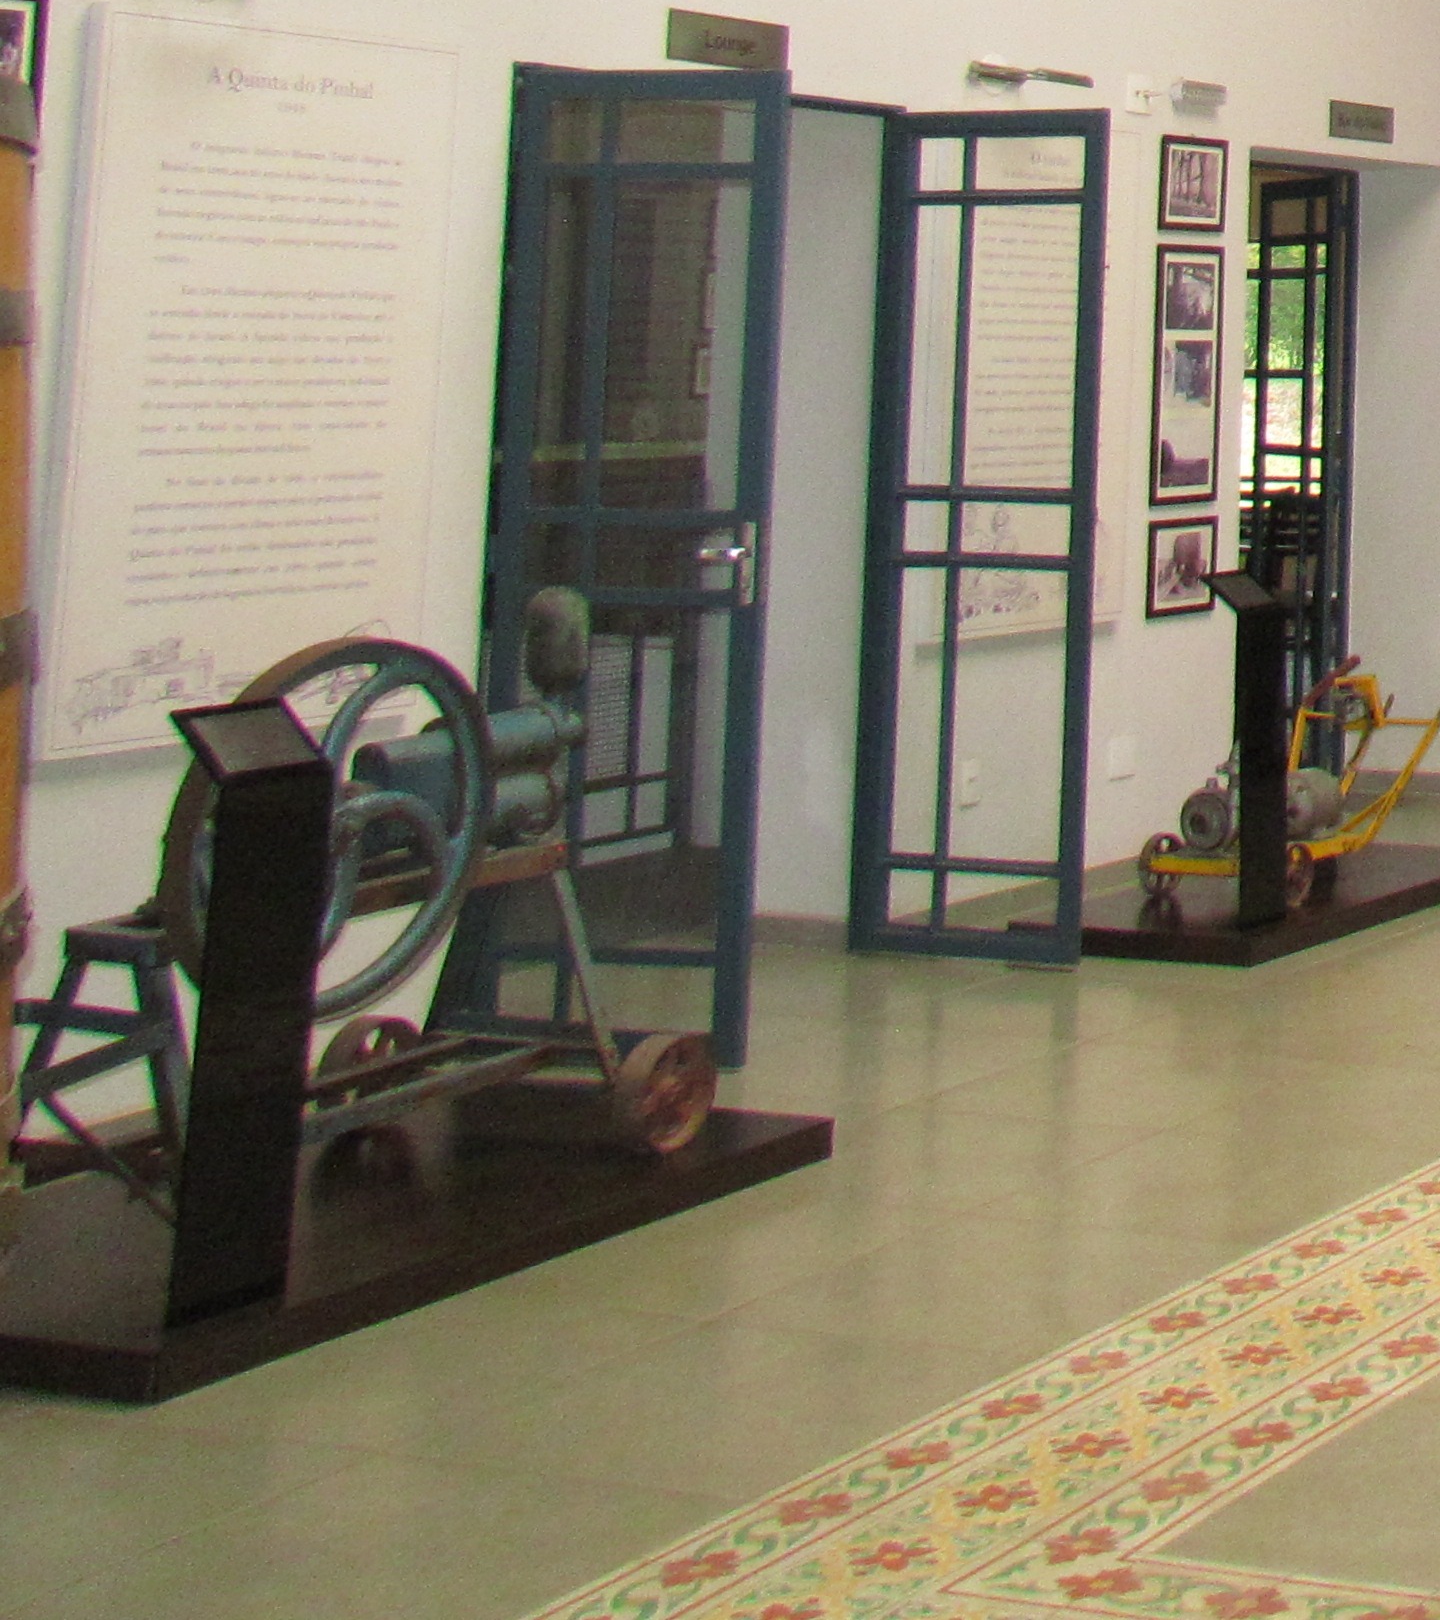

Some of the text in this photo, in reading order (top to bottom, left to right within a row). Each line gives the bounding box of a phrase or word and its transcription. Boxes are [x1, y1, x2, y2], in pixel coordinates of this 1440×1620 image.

[703, 28, 757, 57] Lounge
[207, 65, 374, 99] A Quinta do Pinhal
